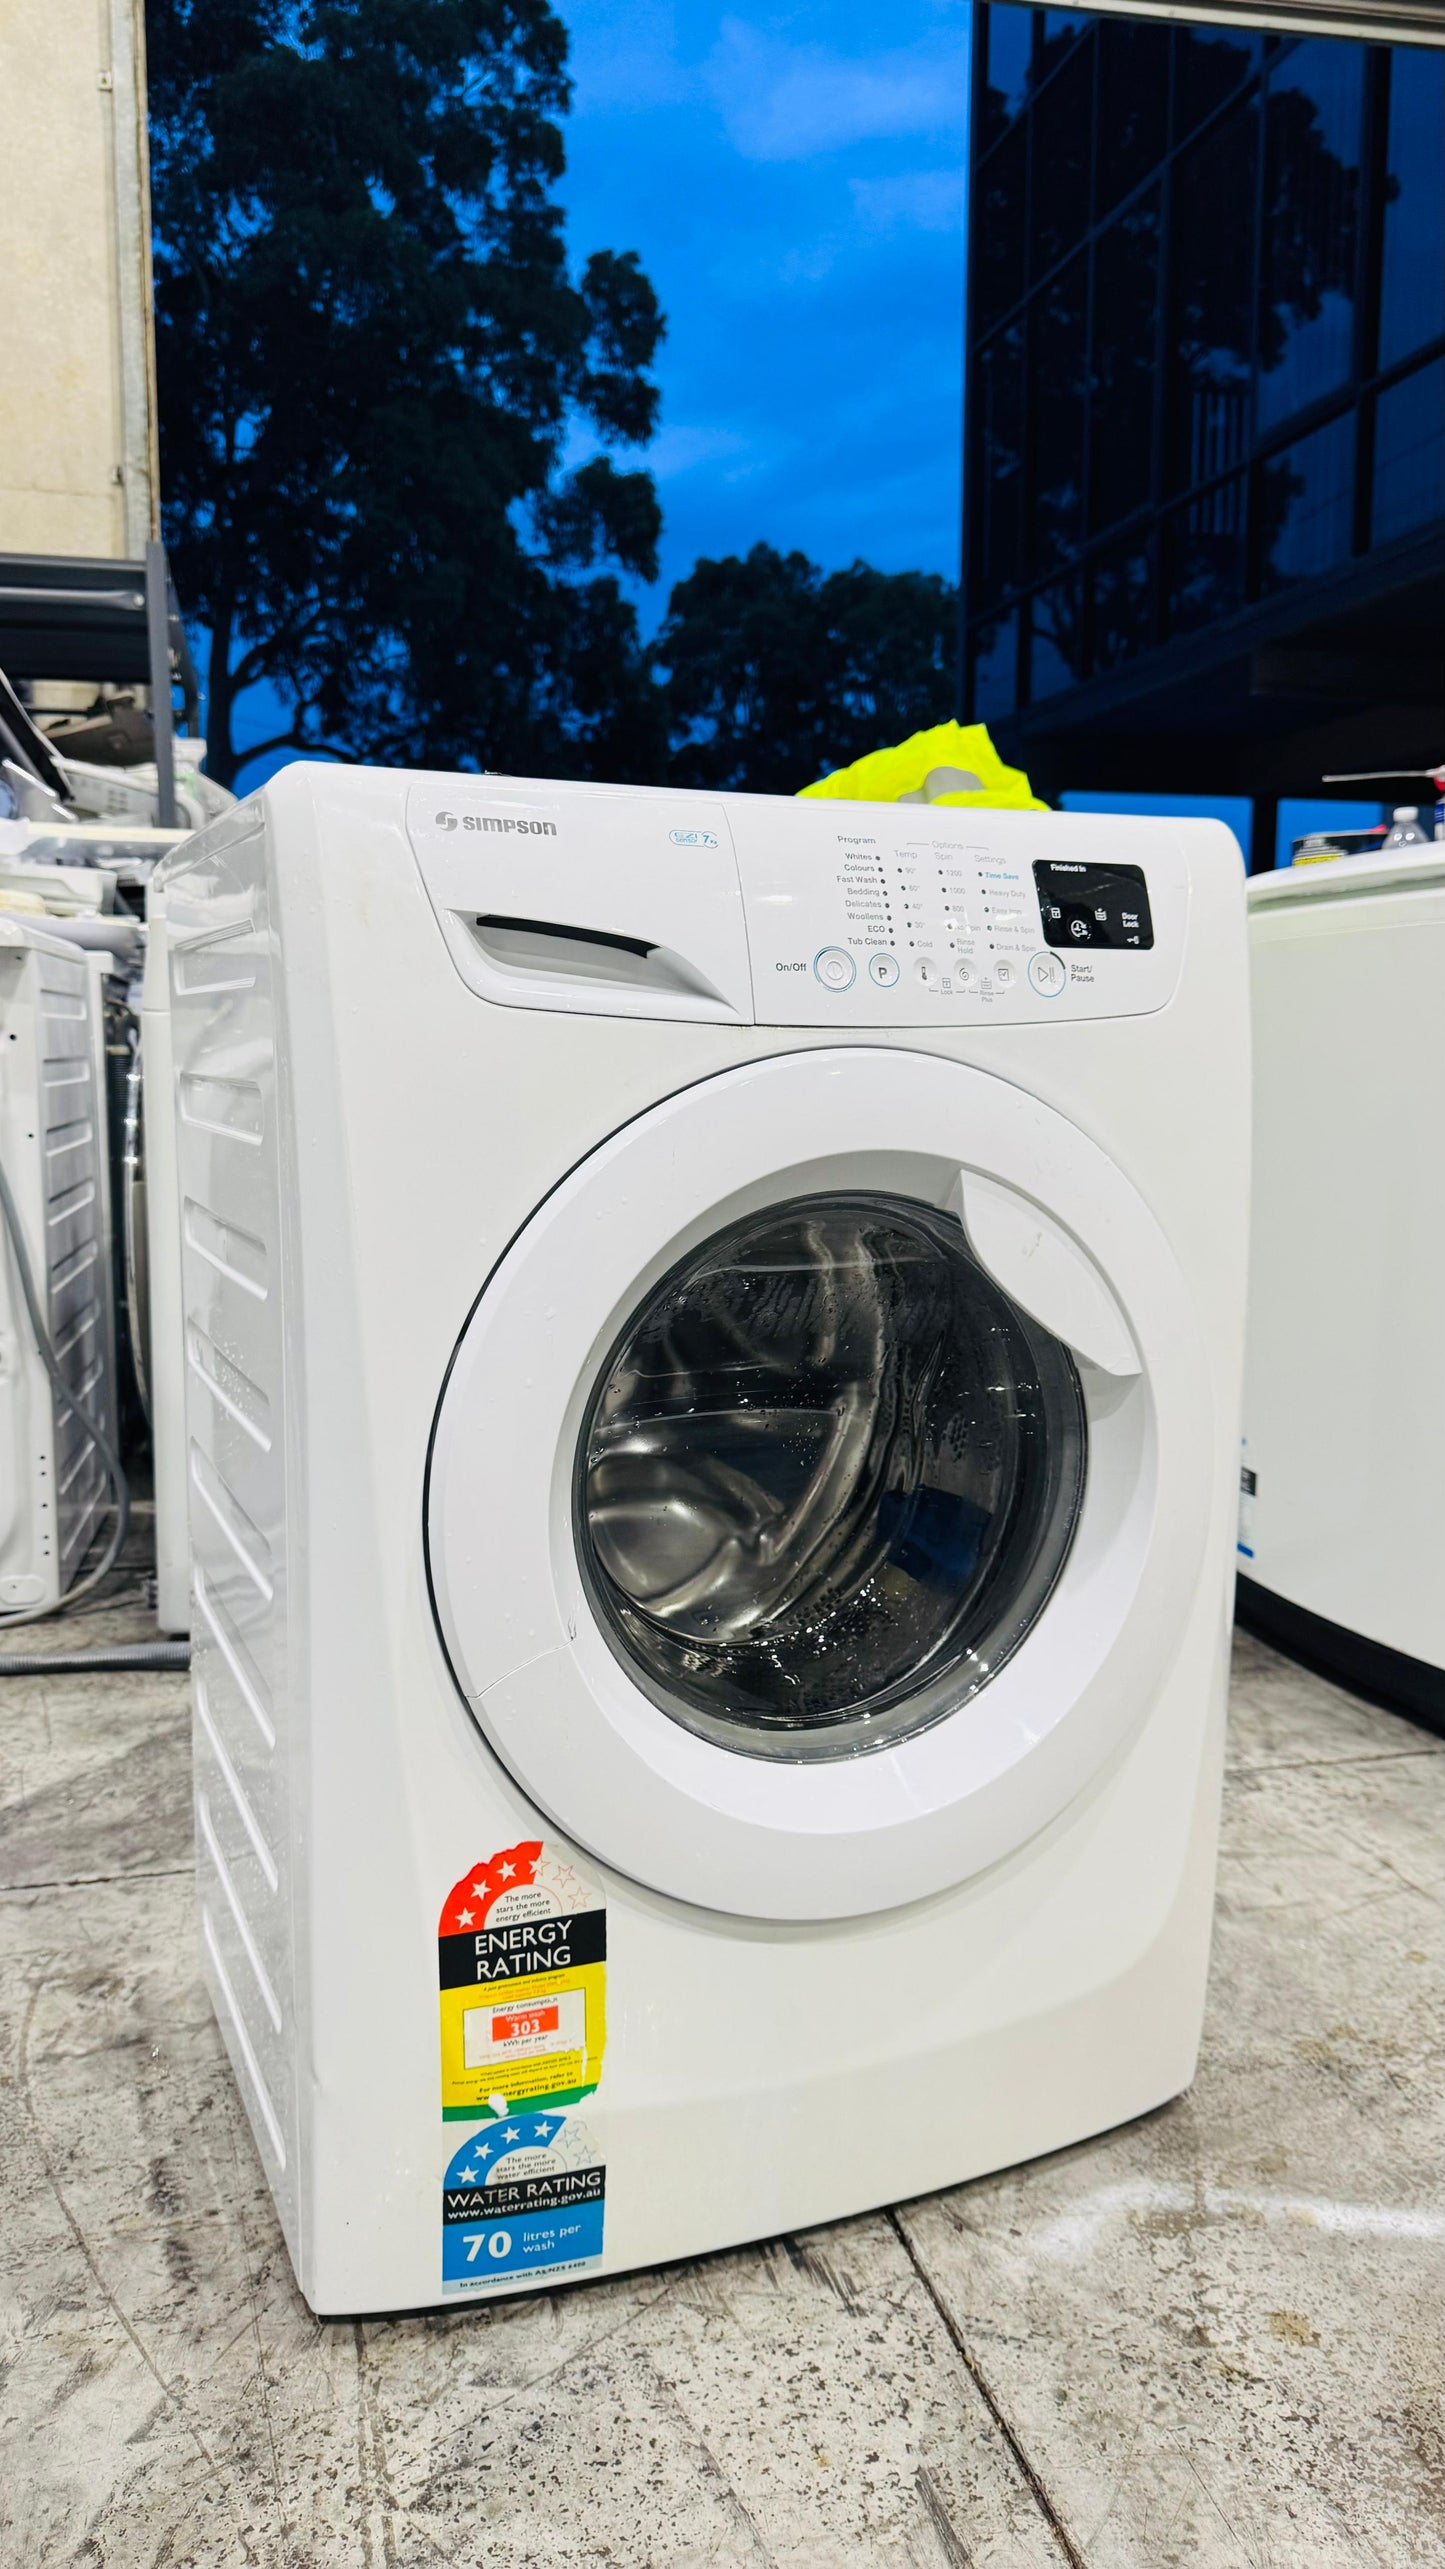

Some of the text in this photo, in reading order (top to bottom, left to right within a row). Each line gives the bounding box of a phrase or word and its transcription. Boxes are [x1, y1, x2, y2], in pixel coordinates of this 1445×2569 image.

[462, 816, 557, 836] SIMPSON
[837, 835, 876, 845] Program
[931, 840, 964, 850] Options
[845, 852, 873, 860] Whites
[894, 850, 918, 859] Temp
[974, 854, 1007, 866] Settings
[844, 863, 875, 872] Colours
[1050, 863, 1079, 873] Finished
[946, 869, 962, 877] 1200
[836, 875, 878, 884] Fast Wash
[847, 886, 880, 897] Bedding
[949, 887, 966, 895] 1000
[989, 889, 1026, 899] Heavy Duty
[845, 899, 882, 908] Delicates
[847, 912, 884, 921] Woollens
[1121, 912, 1139, 921] Door
[867, 925, 886, 933] ECO
[1122, 920, 1139, 928] Lock
[847, 937, 888, 946] Tub Clean
[917, 940, 934, 948] Cold
[957, 946, 974, 954] Hold
[775, 962, 808, 972] On/Off
[878, 967, 888, 979] P
[1071, 973, 1095, 983] Pause
[940, 988, 954, 996] Lock
[505, 1892, 541, 1904] The more
[496, 1899, 550, 1914] stars the more
[496, 1908, 551, 1922] energy efficient
[475, 1920, 572, 1956] ENERGY
[477, 1945, 571, 1980] RATING
[492, 2003, 515, 2014] Energy
[506, 2010, 546, 2022] Warm wash
[511, 2019, 540, 2037] 303
[503, 2038, 520, 2047] kWh
[521, 2036, 532, 2044] per
[534, 2034, 548, 2043] year
[507, 2153, 546, 2165] The more
[534, 2159, 556, 2167] more
[523, 2166, 555, 2176] efficient
[448, 2172, 601, 2208] WATER RATING
[448, 2187, 601, 2219] www.waterrating.gov.au
[523, 2224, 581, 2242] litres per
[462, 2231, 512, 2262] 70
[523, 2240, 555, 2253] wash
[470, 2276, 514, 2287] accordance
